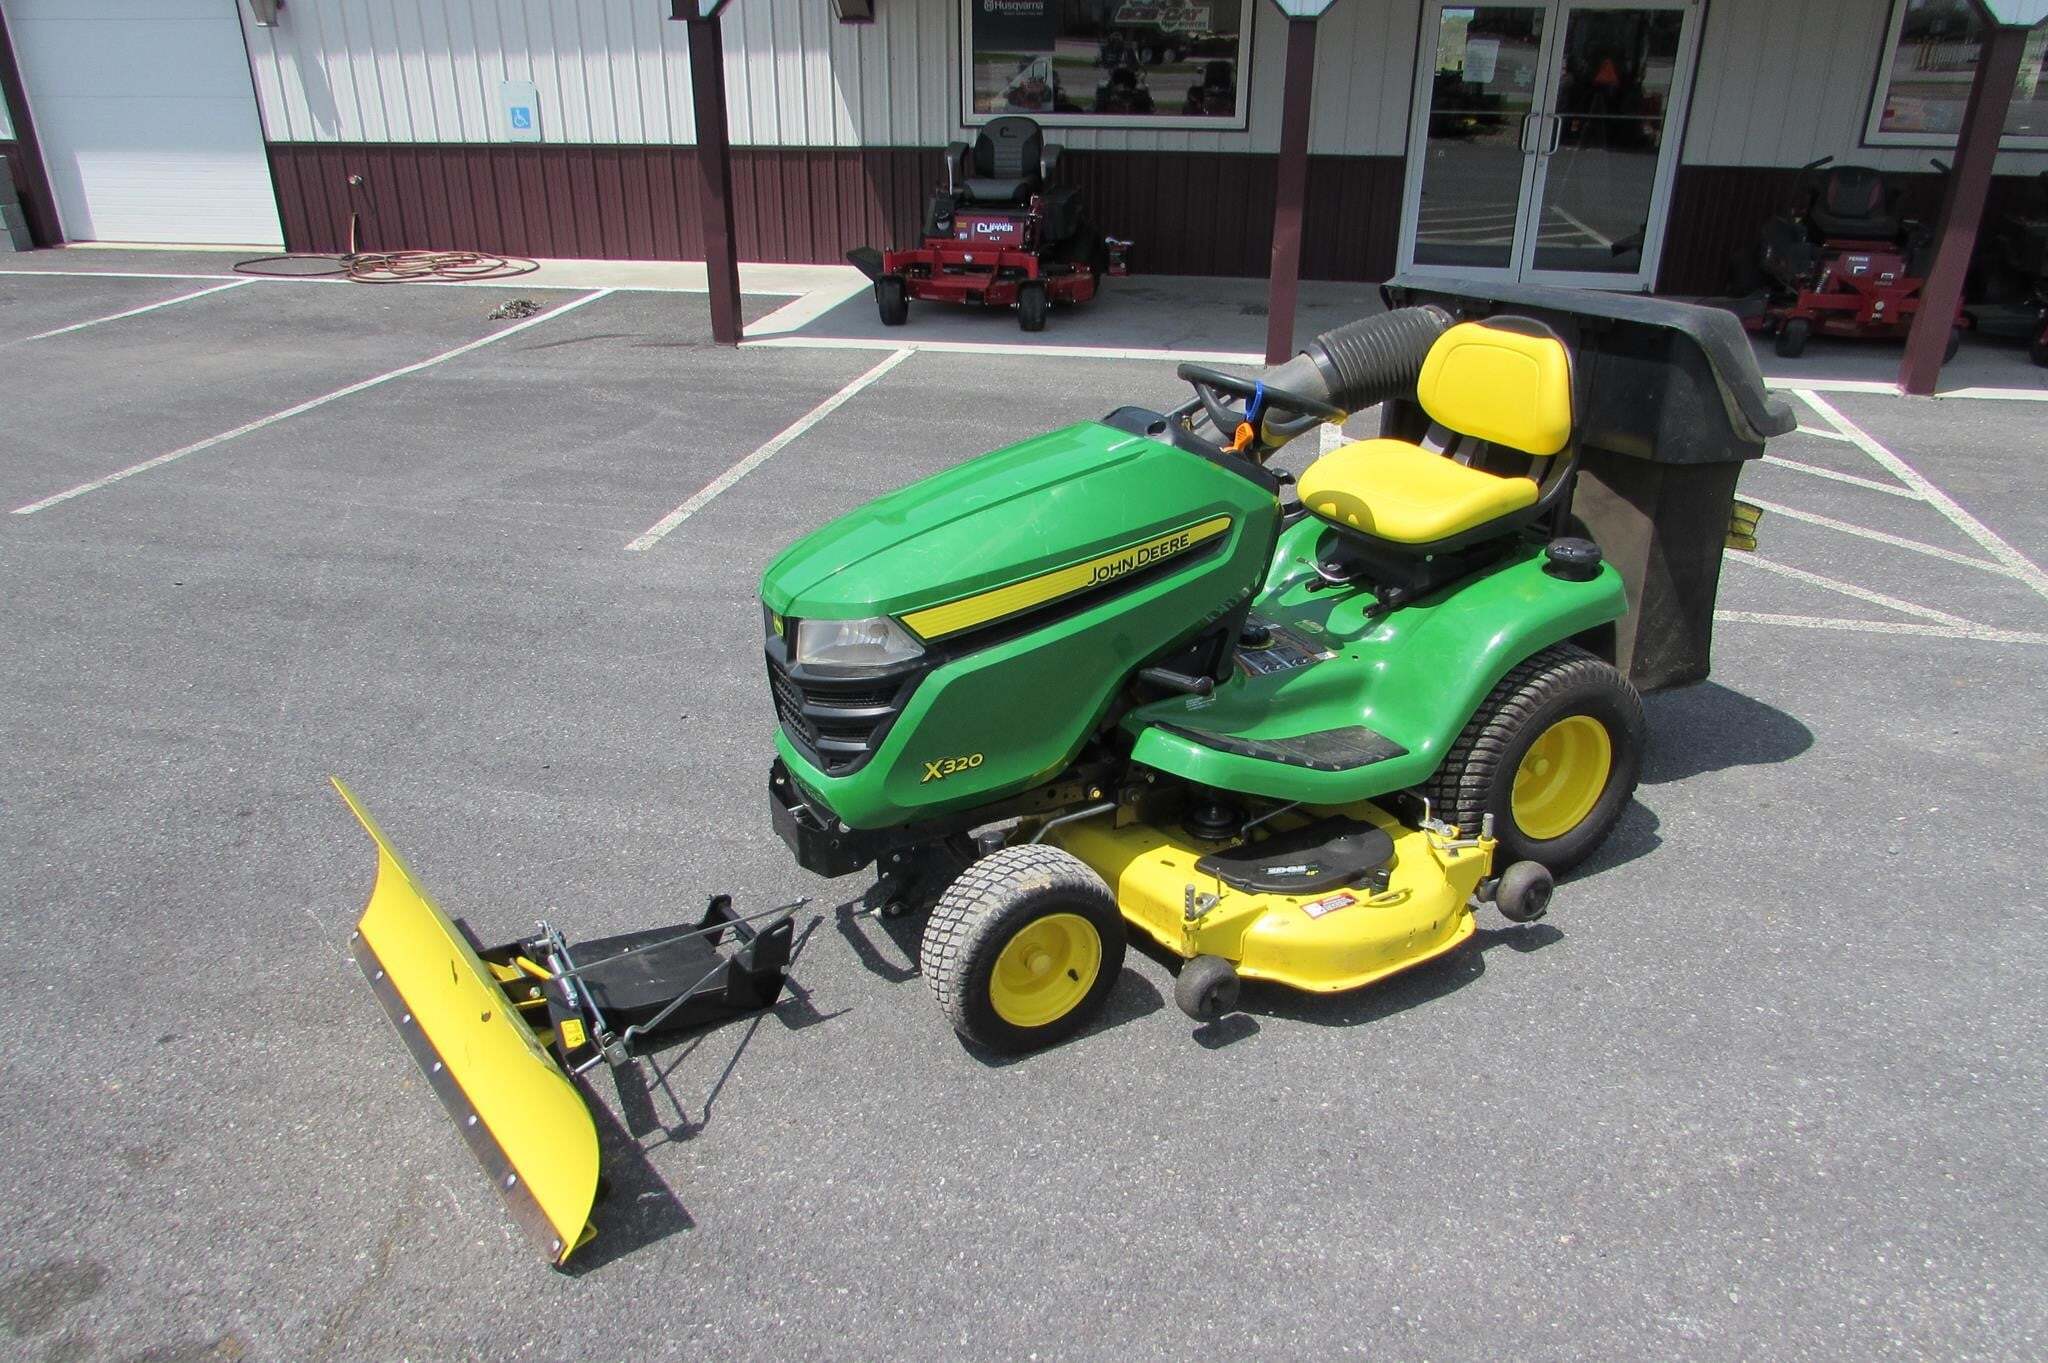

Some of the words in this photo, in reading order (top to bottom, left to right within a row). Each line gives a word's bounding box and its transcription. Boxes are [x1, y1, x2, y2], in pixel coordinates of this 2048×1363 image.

[994, 1, 1044, 11] Husqvarna
[977, 222, 1014, 233] CLIPPER
[1087, 554, 1135, 586] JOHN
[1137, 533, 1191, 567] DEERE
[921, 752, 984, 783] X320
